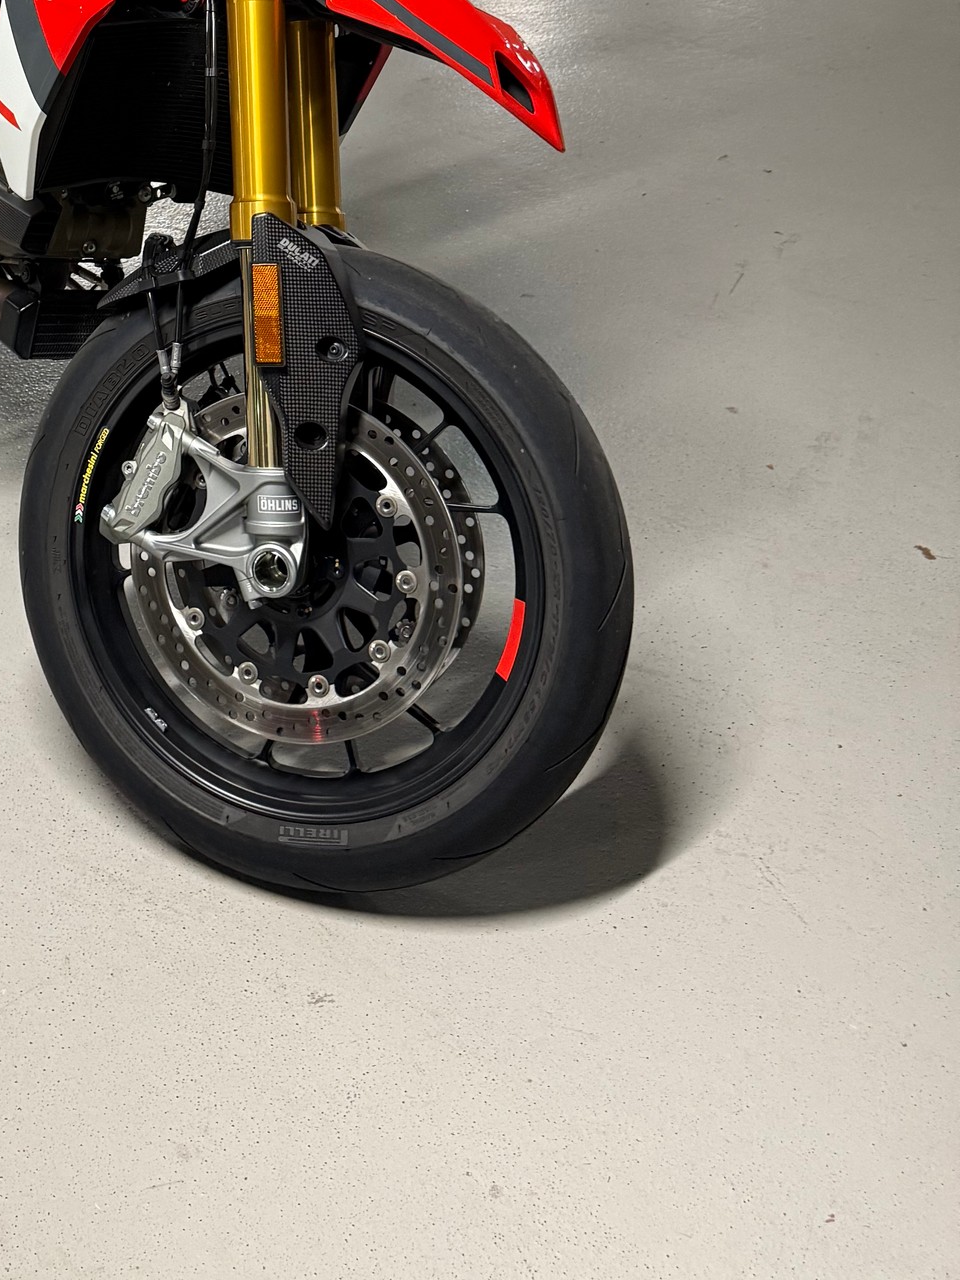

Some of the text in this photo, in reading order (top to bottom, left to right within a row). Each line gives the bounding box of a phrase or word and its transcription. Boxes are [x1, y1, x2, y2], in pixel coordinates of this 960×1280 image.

[280, 237, 320, 267] DUCATI
[73, 340, 152, 437] DIABLO
[93, 427, 110, 454] FORGED
[124, 451, 167, 518] brembo
[260, 496, 299, 511] ÖHLINS
[277, 825, 349, 846] PIRELLI
